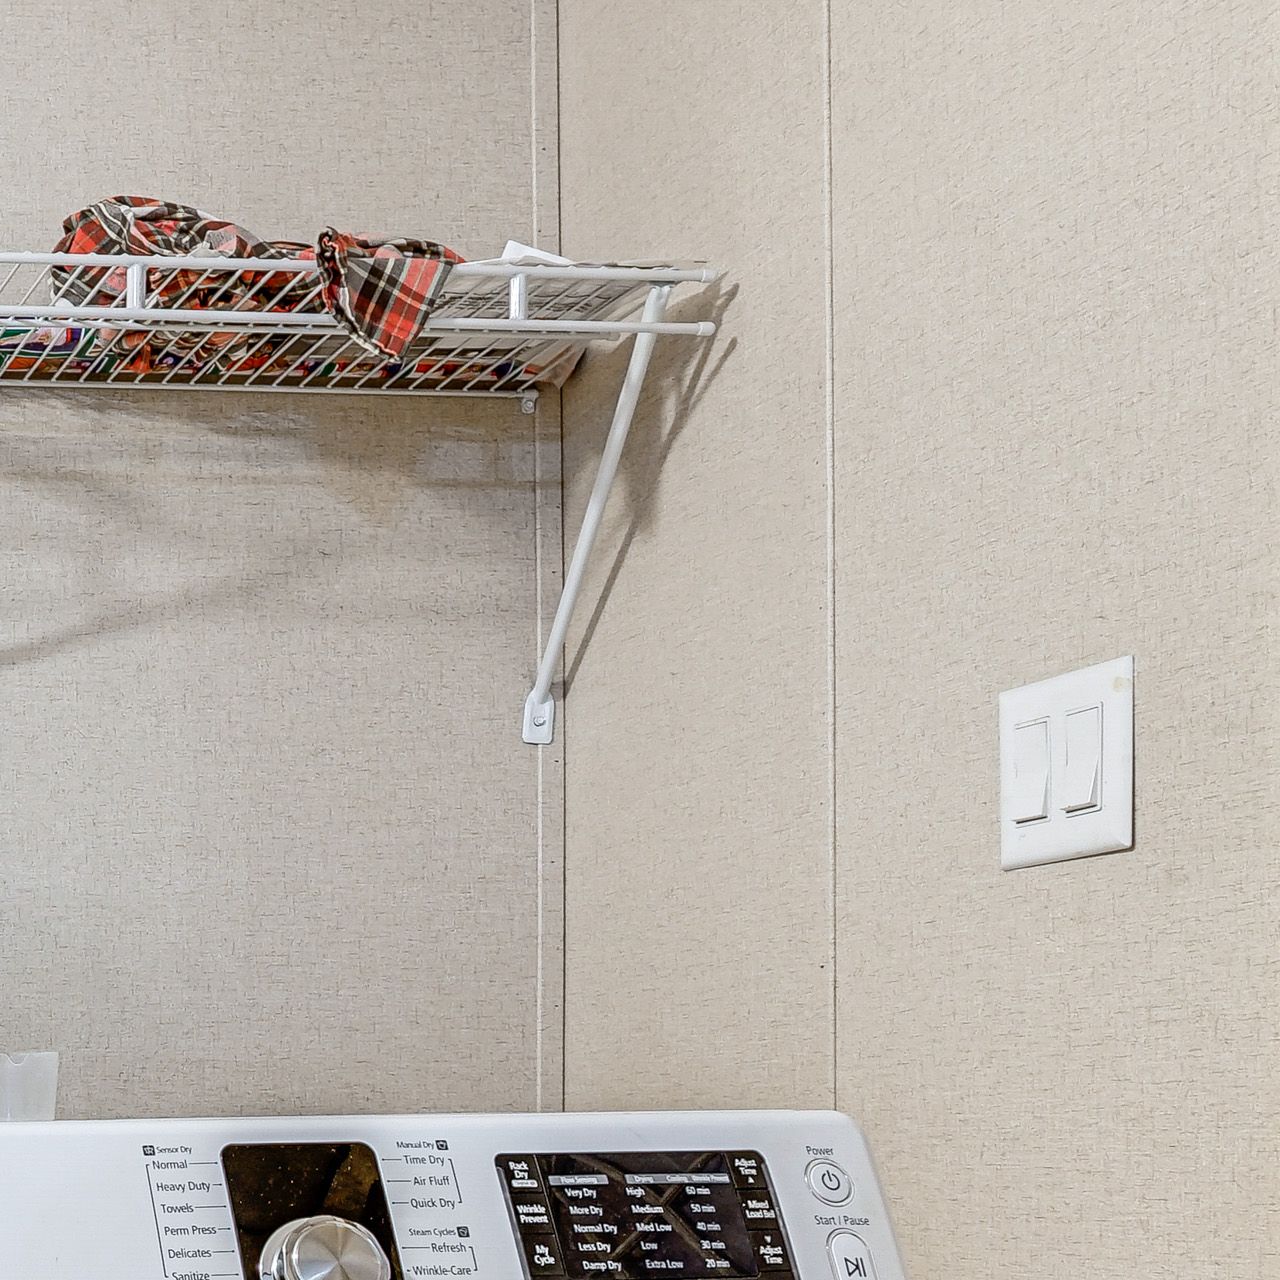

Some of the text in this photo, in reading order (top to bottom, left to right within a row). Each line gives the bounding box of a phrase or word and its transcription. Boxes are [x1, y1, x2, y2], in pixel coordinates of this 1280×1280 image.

[180, 1146, 192, 1154] Dry
[396, 1141, 434, 1150] Manual Dry
[806, 1146, 834, 1155] Power
[152, 1160, 188, 1169] Normal
[404, 1155, 445, 1166] Time Dry
[509, 1161, 529, 1170] Rack
[514, 1170, 528, 1180] Dry
[413, 1176, 450, 1185] Air Fluff
[156, 1181, 211, 1193] Heavy Duty
[625, 1186, 645, 1198] High
[685, 1185, 711, 1195] 60 min
[564, 1188, 597, 1199] Very Dry
[160, 1203, 194, 1213] Towels
[410, 1198, 455, 1210] Quick Dry
[516, 1204, 546, 1214] Wrinkle
[631, 1204, 664, 1214] Medium
[690, 1203, 716, 1213] 50 min
[569, 1206, 603, 1216] More Dry
[520, 1215, 549, 1224] Prevent
[814, 1215, 870, 1226] Start Pause
[164, 1225, 217, 1235] Perm Press
[573, 1223, 618, 1234] Normal Dry
[635, 1222, 672, 1232] Med Low
[707, 1221, 721, 1231] min
[409, 1228, 456, 1238] Steam Cycles
[431, 1242, 467, 1253] Refresh
[578, 1242, 611, 1253] Less Dry
[640, 1241, 658, 1250] Low
[700, 1240, 726, 1249] 30 min
[168, 1248, 212, 1259] Delicates
[535, 1245, 549, 1256] My
[534, 1255, 555, 1266] Cycle
[645, 1259, 684, 1269] Extra Low
[705, 1258, 731, 1268] 20 min
[582, 1261, 622, 1272] Damp Dry
